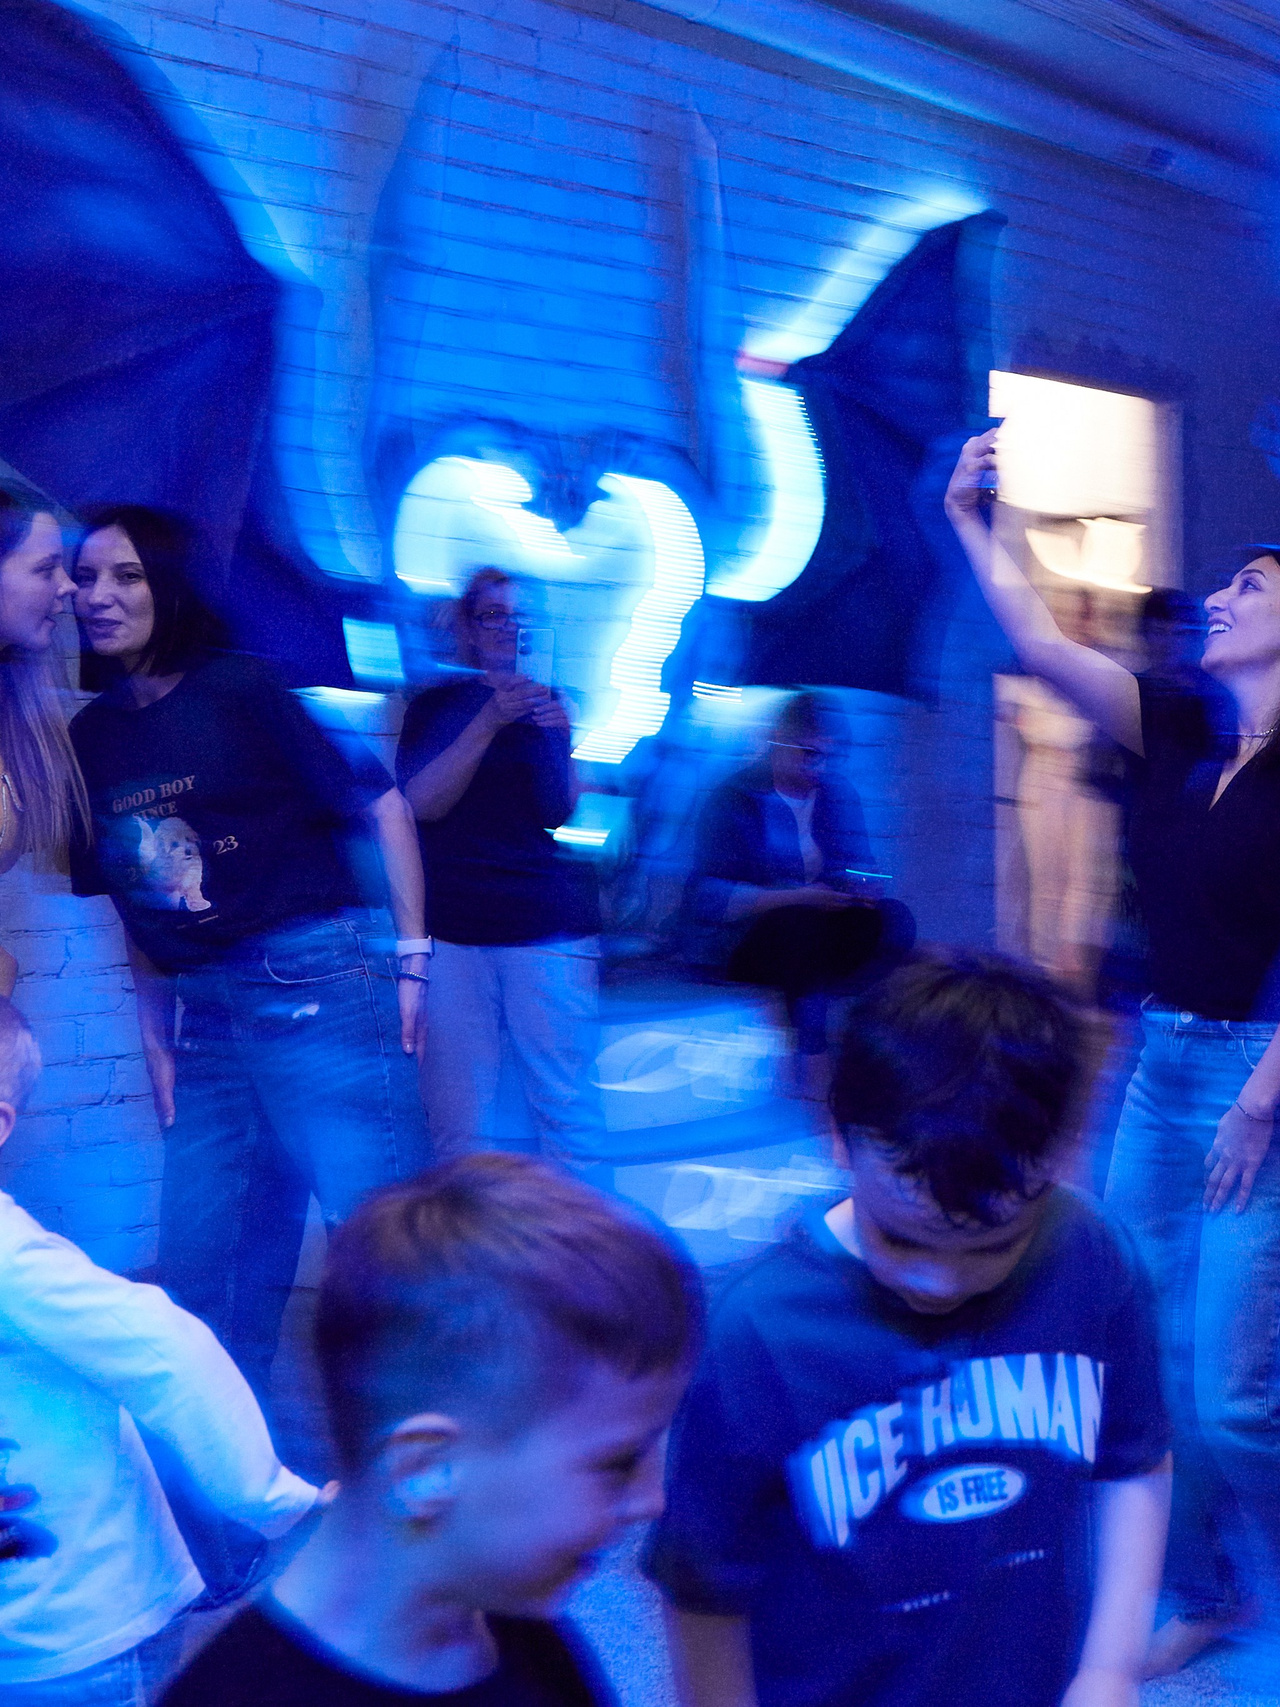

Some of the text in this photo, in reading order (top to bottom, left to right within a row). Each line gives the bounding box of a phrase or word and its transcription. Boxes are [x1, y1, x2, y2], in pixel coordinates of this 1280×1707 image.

[112, 775, 195, 813] GOOD BOY
[213, 835, 239, 855] 23
[936, 1469, 1009, 1515] IS FREE
